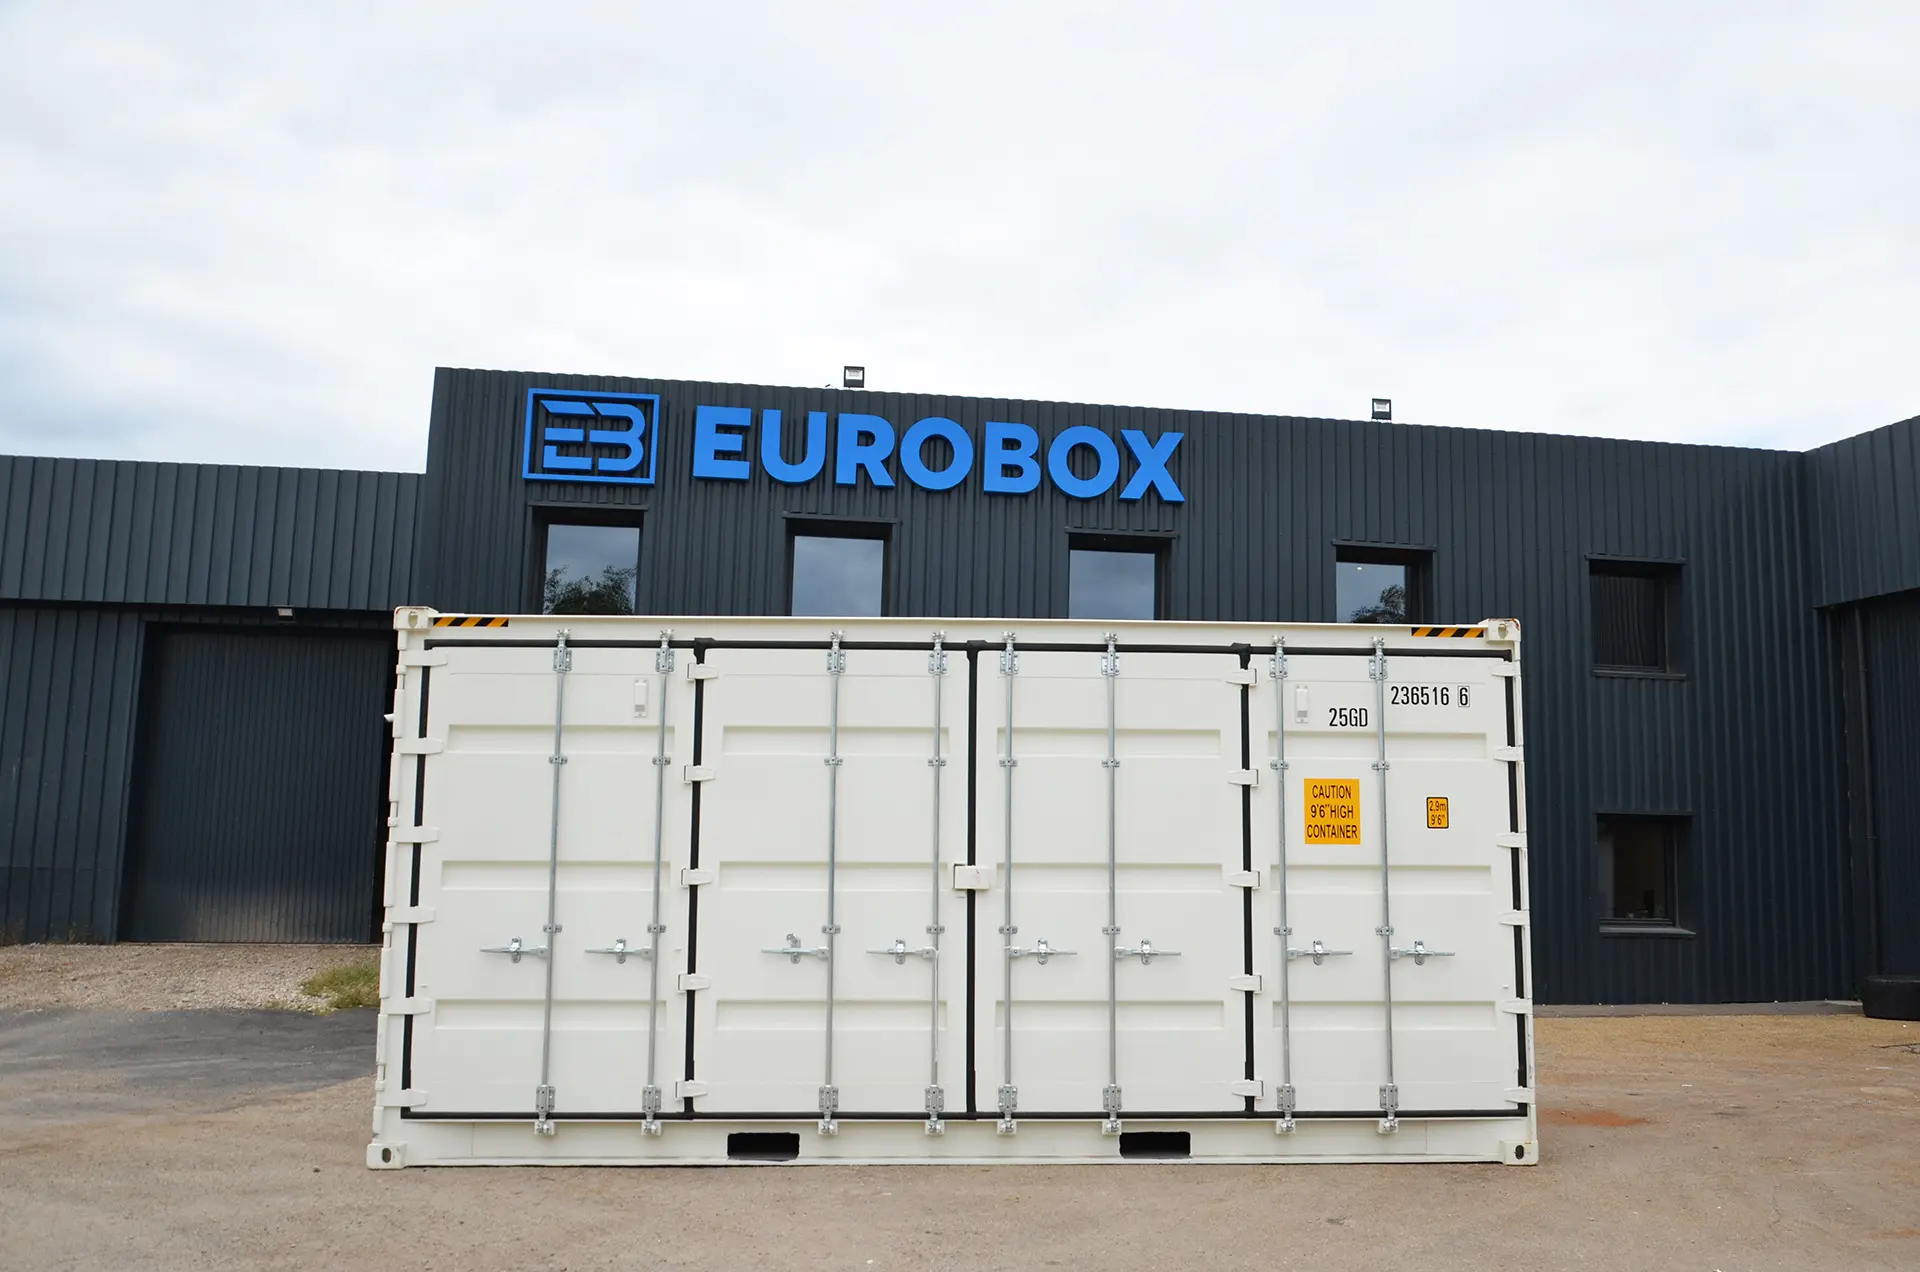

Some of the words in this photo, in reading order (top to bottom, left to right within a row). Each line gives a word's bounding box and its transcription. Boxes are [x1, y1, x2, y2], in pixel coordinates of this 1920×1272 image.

[693, 405, 1185, 502] EUROBOX
[1391, 686, 1449, 706] 236516
[1459, 687, 1469, 706] 6
[1329, 708, 1368, 727] 25GD
[1312, 785, 1351, 799] CAUTION
[1307, 824, 1358, 838] CONTAINER
